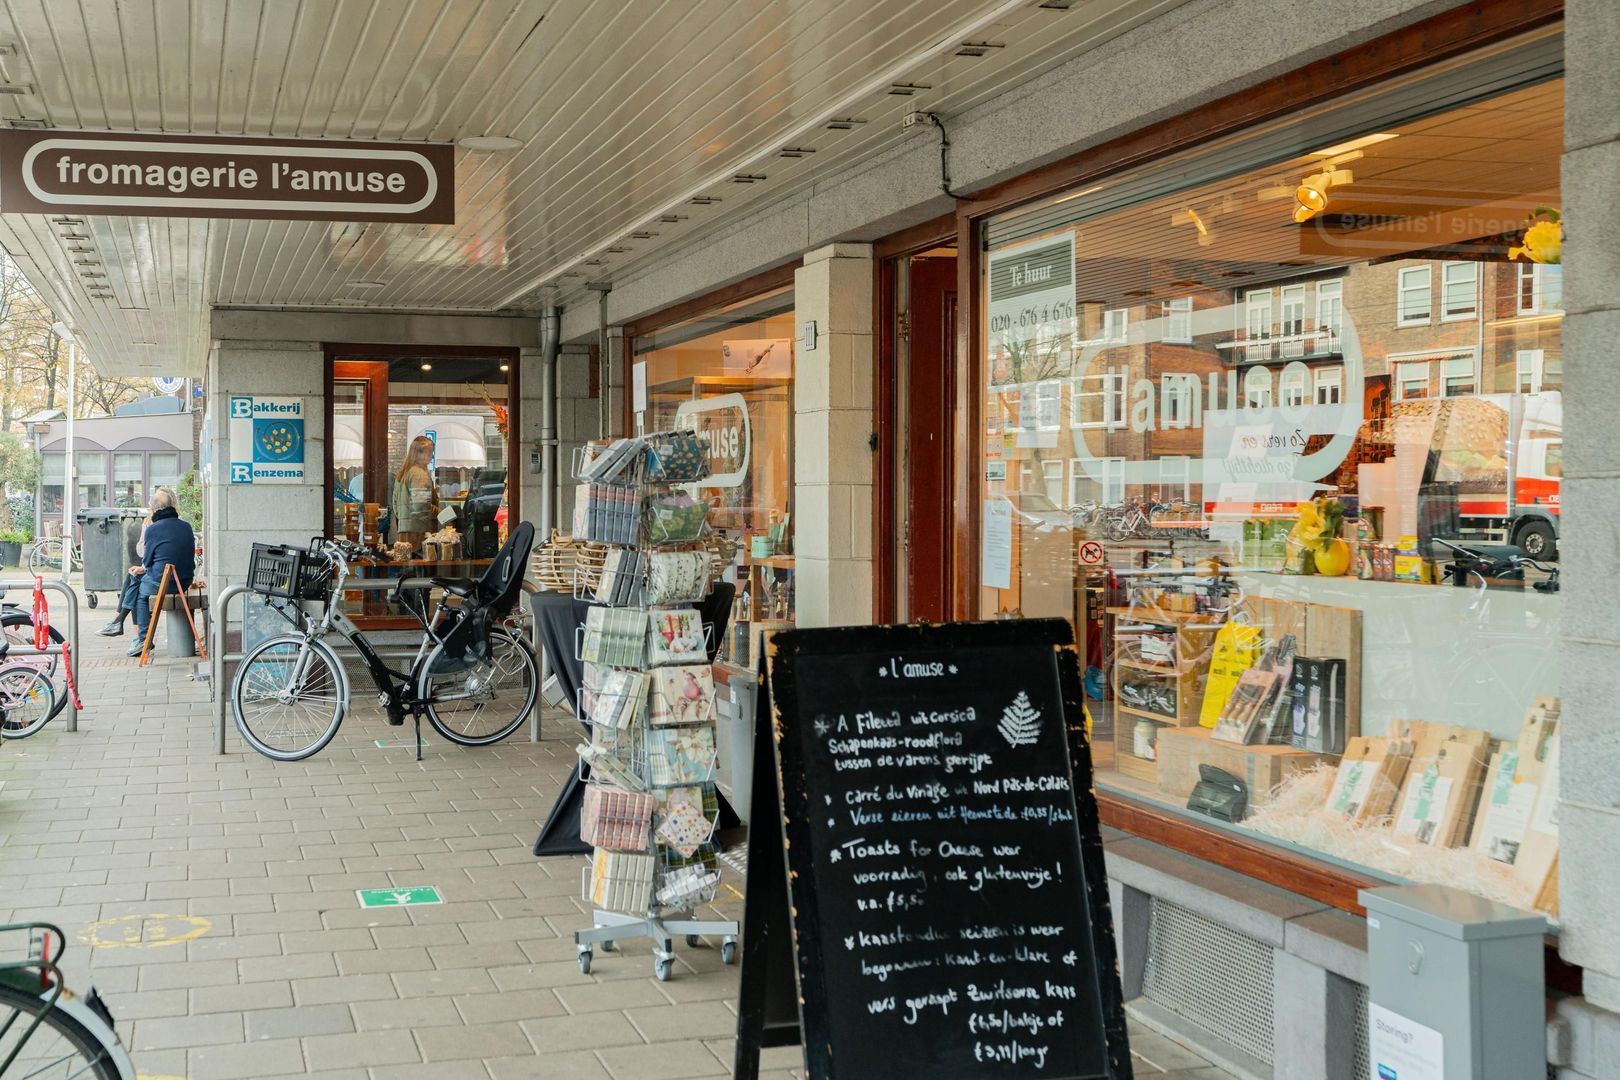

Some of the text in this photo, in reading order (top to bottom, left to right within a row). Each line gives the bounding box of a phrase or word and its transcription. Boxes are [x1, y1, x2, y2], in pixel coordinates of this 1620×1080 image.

[56, 156, 406, 193] fromagerie l'amuse
[1009, 262, 1052, 288] Te huur
[991, 313, 1011, 332] 020
[1019, 305, 1038, 327] 676
[1041, 304, 1048, 322] 4
[1053, 298, 1073, 320] 676
[232, 398, 301, 418] Bakkerij
[232, 464, 304, 482] Renzema
[890, 656, 944, 678] l'amuse
[837, 714, 849, 732] A
[930, 706, 976, 723] Corsica
[834, 753, 993, 773] tussen de varens gerijpt
[886, 784, 903, 800] du
[906, 783, 950, 804] Vinage
[973, 780, 1000, 795] Nord
[849, 807, 884, 826] Verse
[891, 810, 931, 822] eieren
[937, 805, 956, 819] uit
[842, 837, 900, 859] Toasts
[945, 865, 968, 880] ook
[1030, 925, 1064, 936] weer
[1062, 950, 1078, 967] of
[867, 996, 896, 1014] vers
[903, 987, 958, 1025] geraspt
[1045, 980, 1077, 1000] kaas
[1047, 1009, 1065, 1027] of
